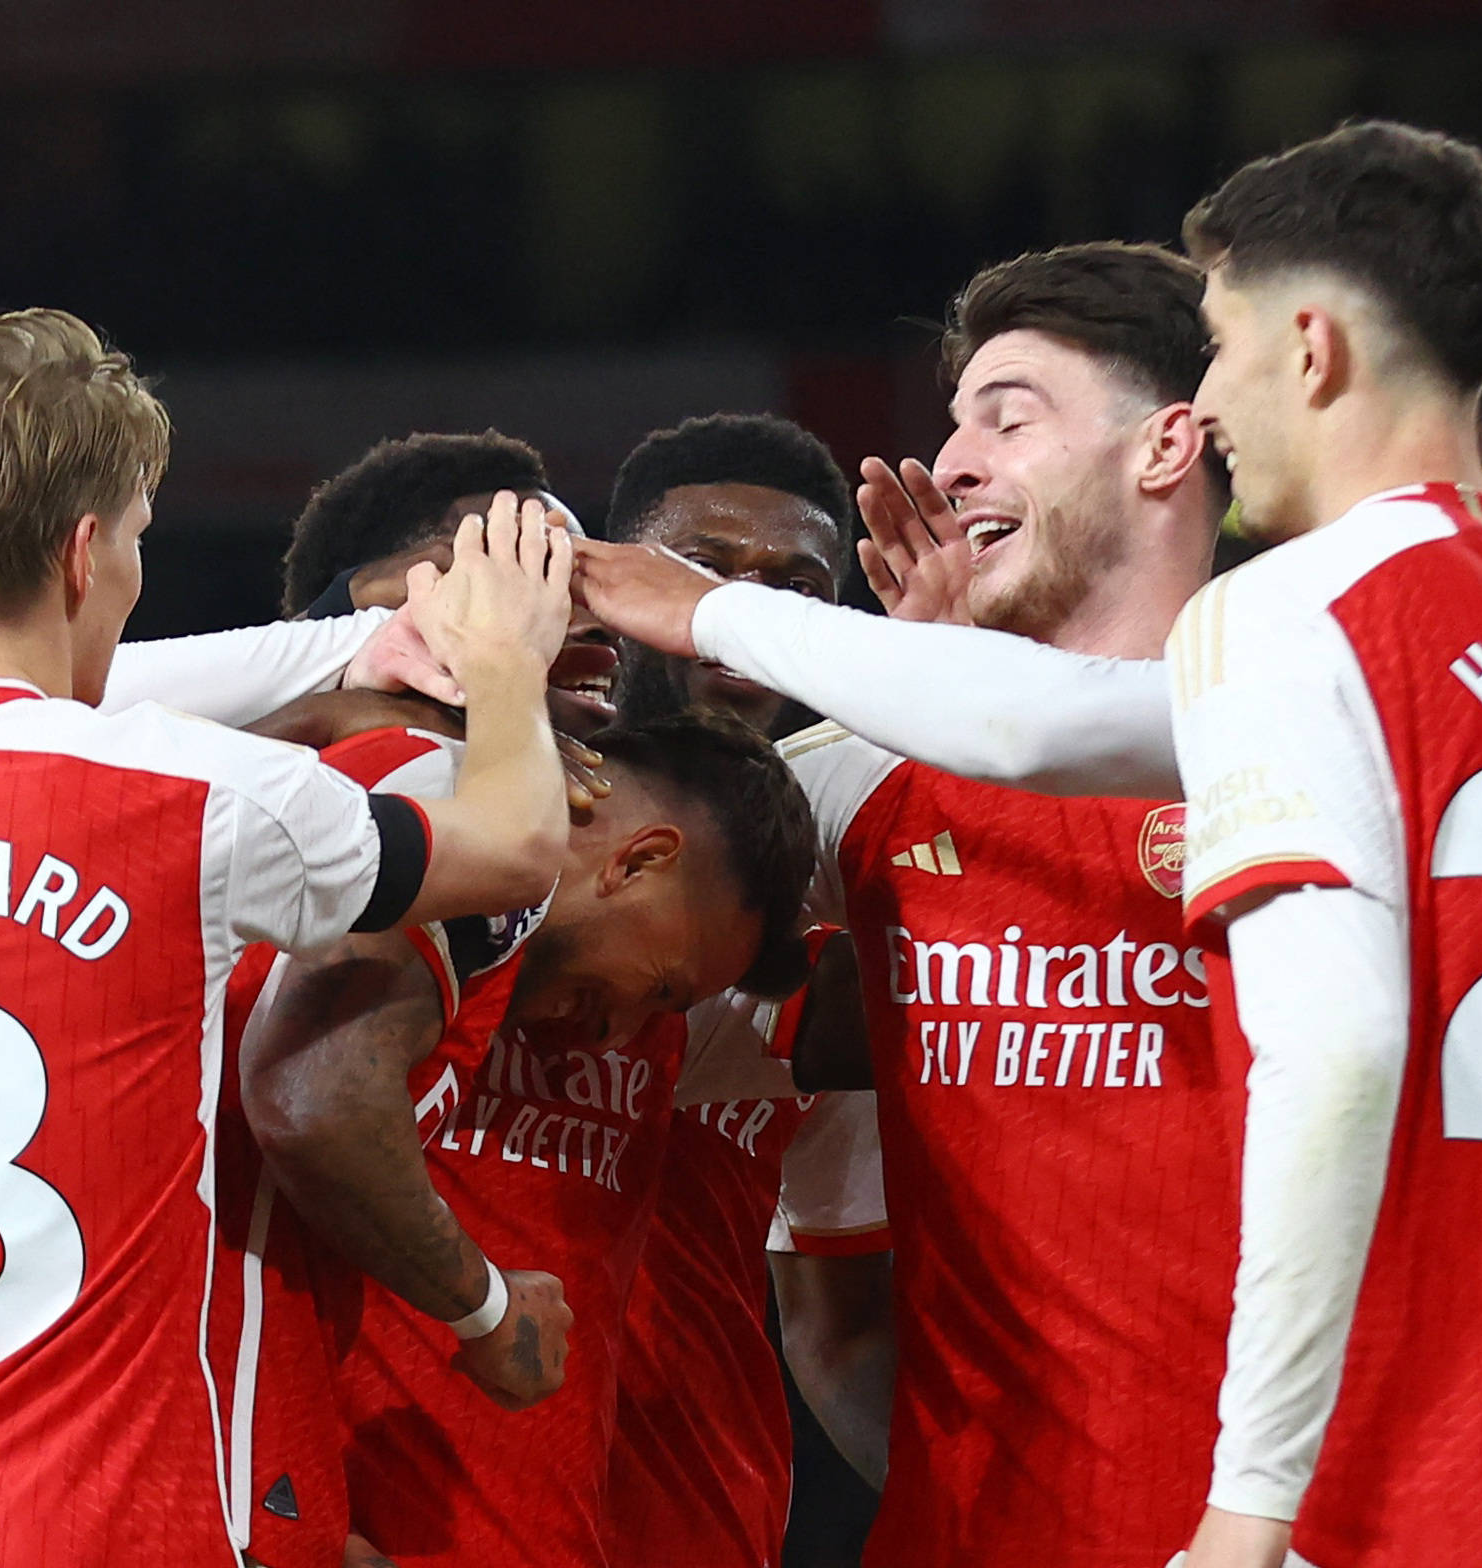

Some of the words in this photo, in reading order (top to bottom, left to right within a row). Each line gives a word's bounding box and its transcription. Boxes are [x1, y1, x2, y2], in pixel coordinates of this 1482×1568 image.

[885, 925, 1211, 1008] Emirates
[919, 1020, 982, 1087] FLY
[993, 1020, 1165, 1088] BETTER
